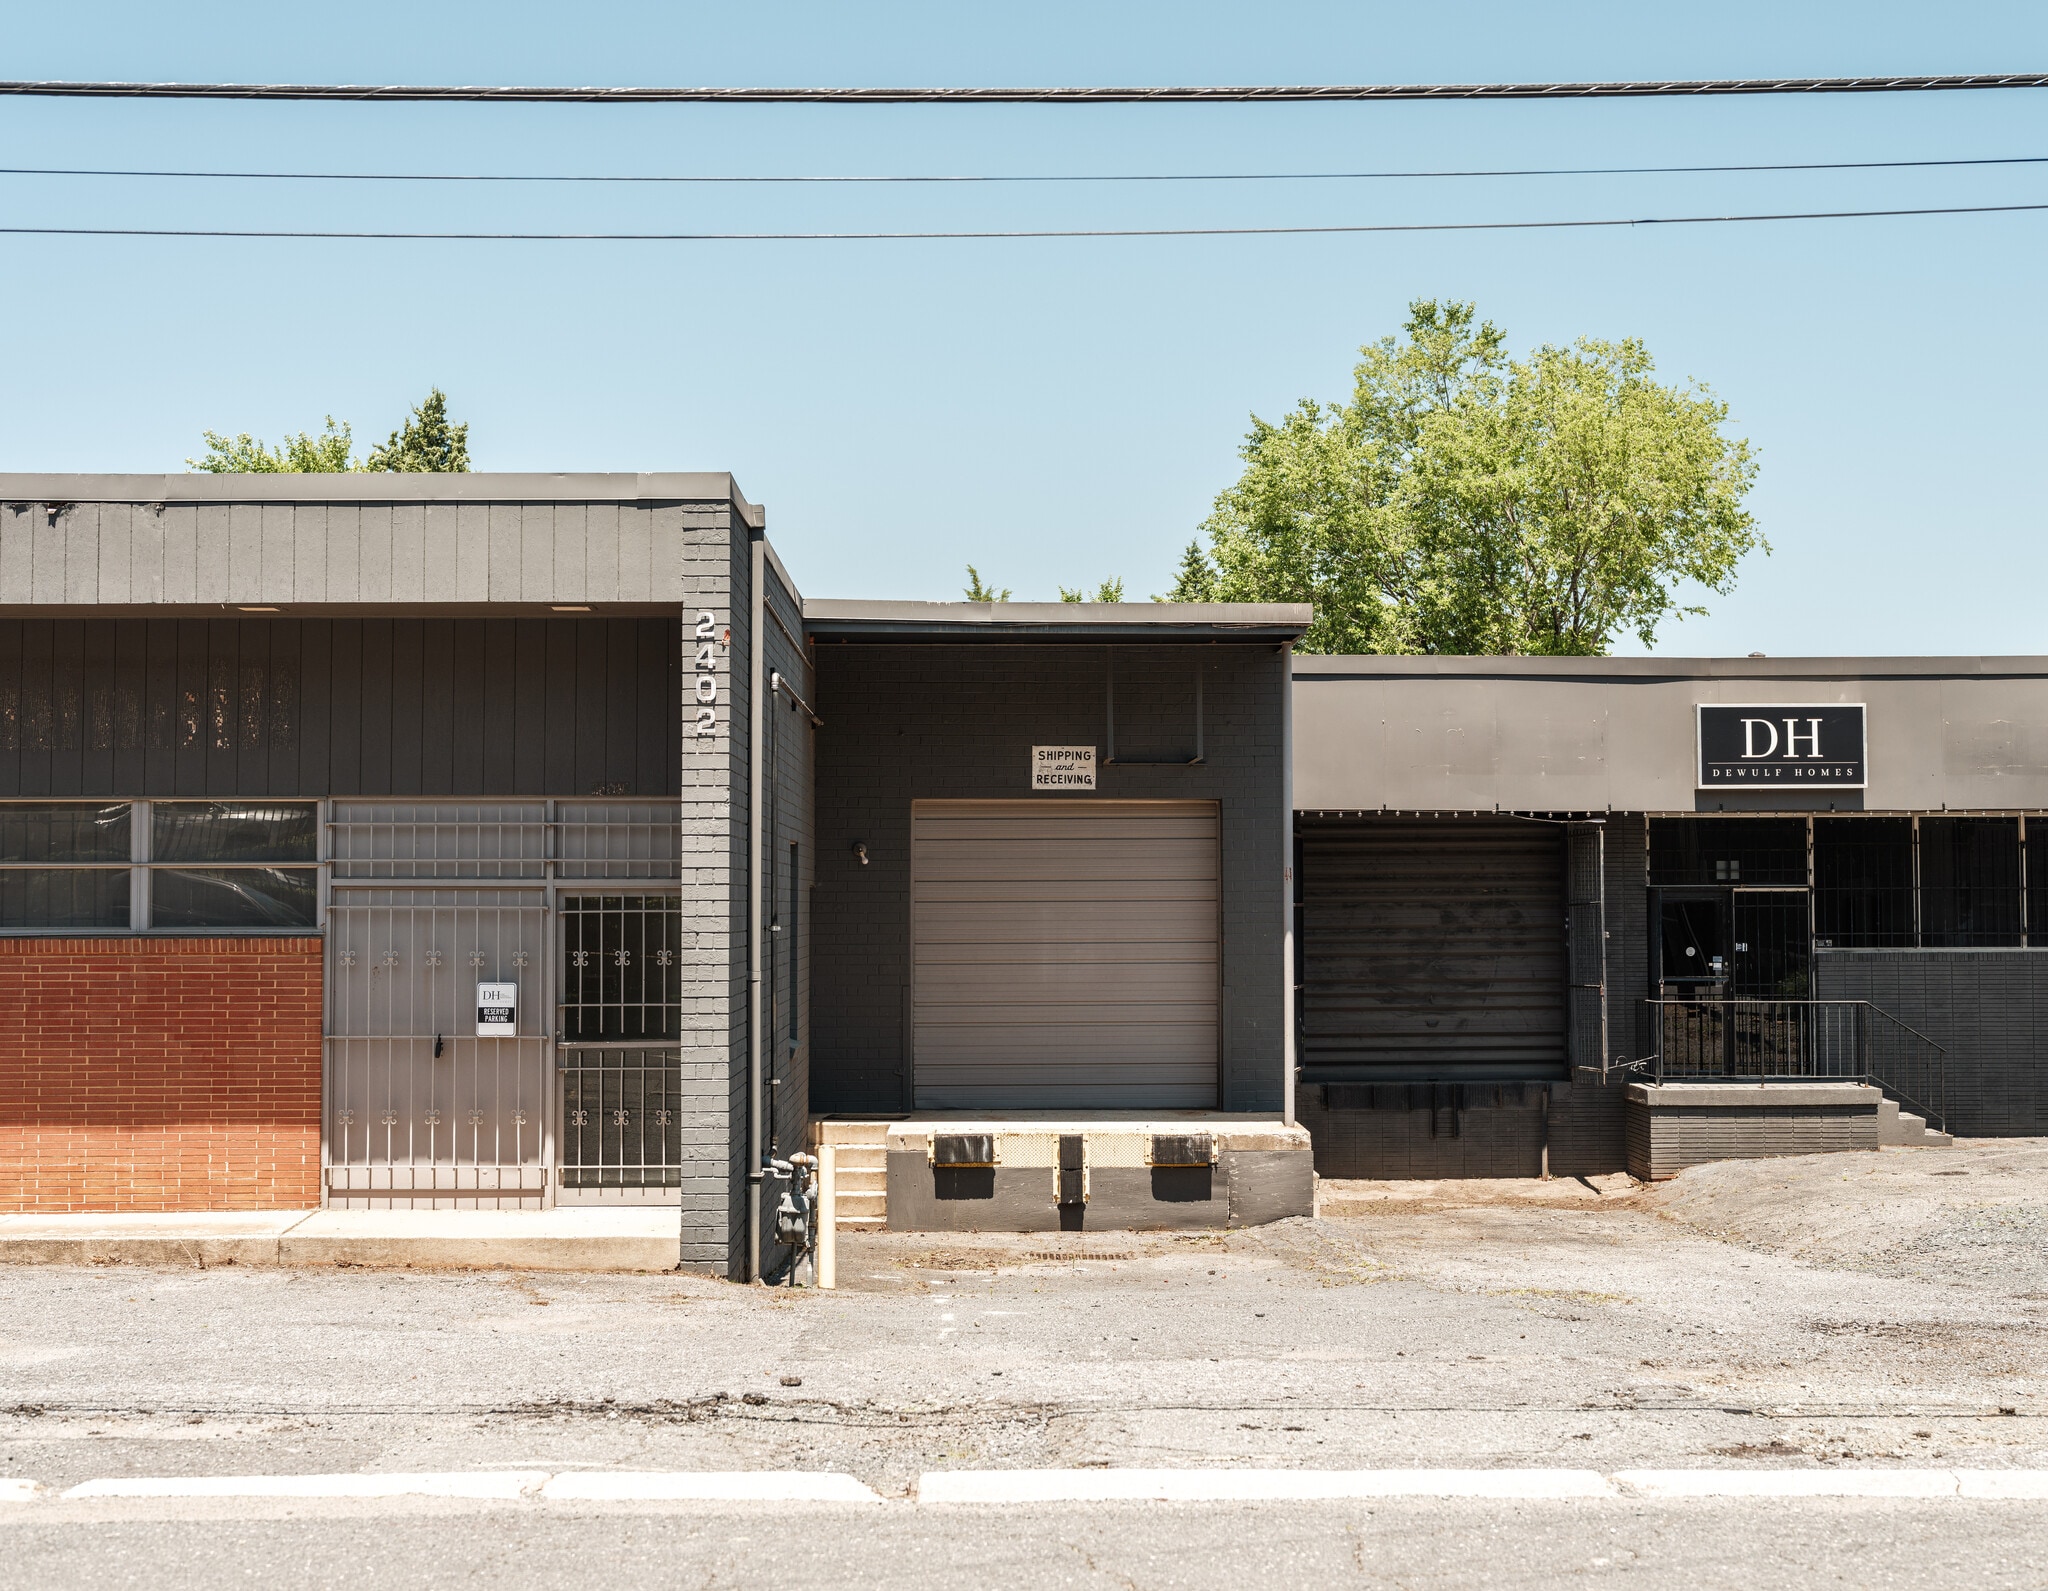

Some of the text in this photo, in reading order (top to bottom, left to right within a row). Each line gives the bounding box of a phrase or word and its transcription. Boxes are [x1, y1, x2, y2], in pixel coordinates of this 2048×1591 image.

[695, 611, 716, 734] 2402
[1740, 718, 1824, 758] DH
[1038, 750, 1091, 761] SHIPPING
[1055, 762, 1075, 771] and
[1712, 768, 1854, 777] DEWULF HOMES
[1036, 774, 1092, 785] RECEIVING
[483, 990, 500, 1000] DH
